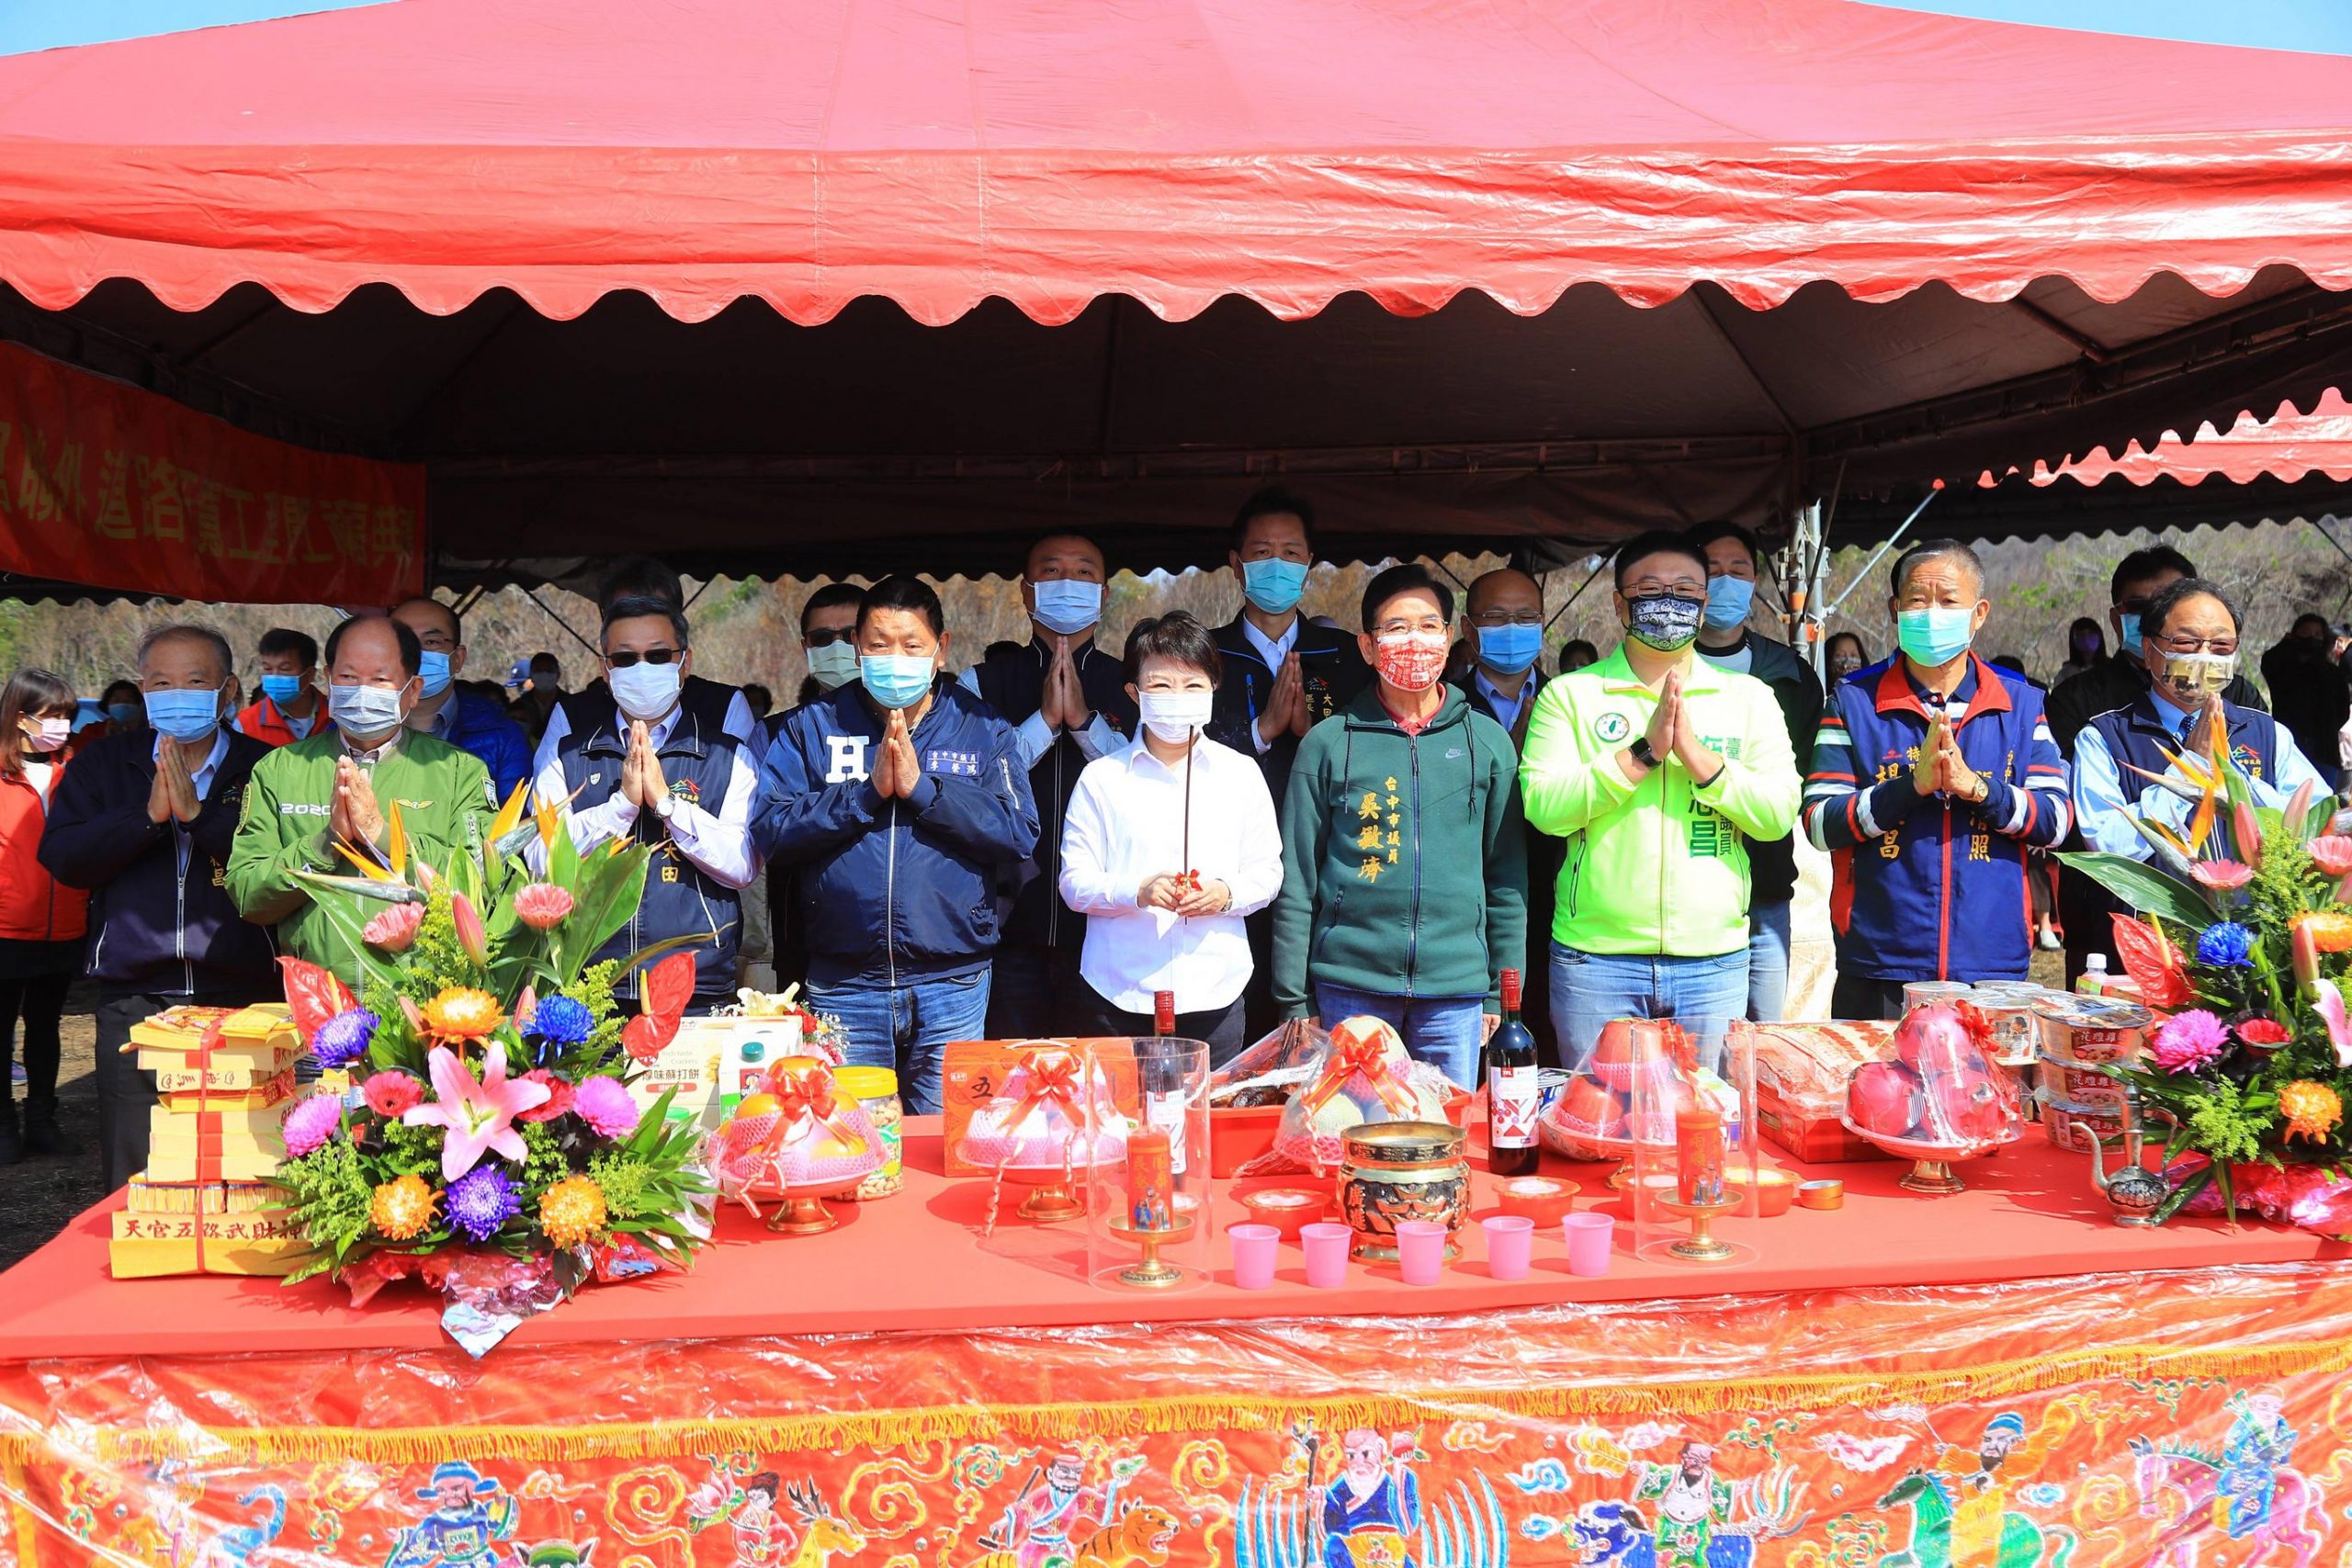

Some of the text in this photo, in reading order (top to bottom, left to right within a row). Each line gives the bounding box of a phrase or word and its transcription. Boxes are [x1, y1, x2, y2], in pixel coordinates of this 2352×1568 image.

[825, 735, 871, 784] H
[1357, 792, 1385, 884] 吳敏濟
[1385, 776, 1401, 864] 台中市議員
